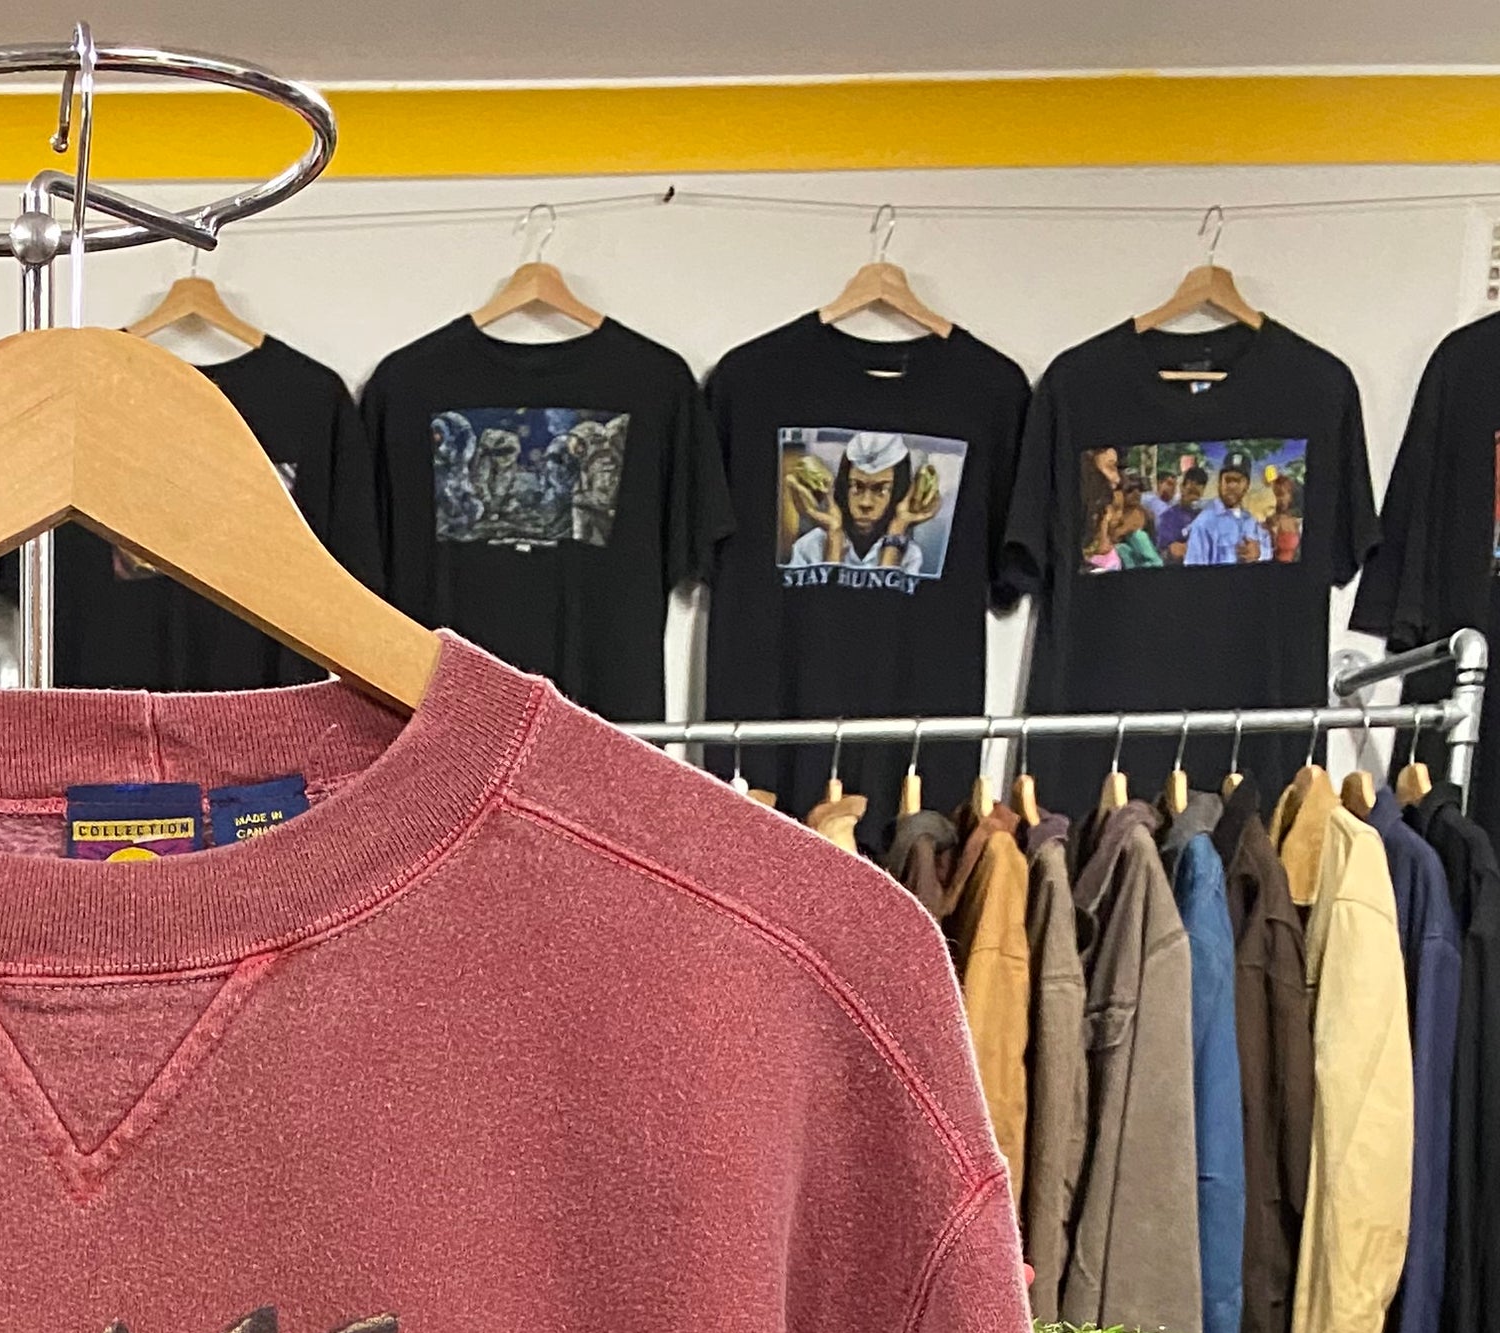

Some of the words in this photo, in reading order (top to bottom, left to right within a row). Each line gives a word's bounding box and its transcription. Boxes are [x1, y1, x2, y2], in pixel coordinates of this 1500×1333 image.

[782, 567, 831, 587] STAY
[235, 813, 267, 827] MADE
[271, 810, 283, 821] IN
[78, 822, 190, 837] COLLECTION
